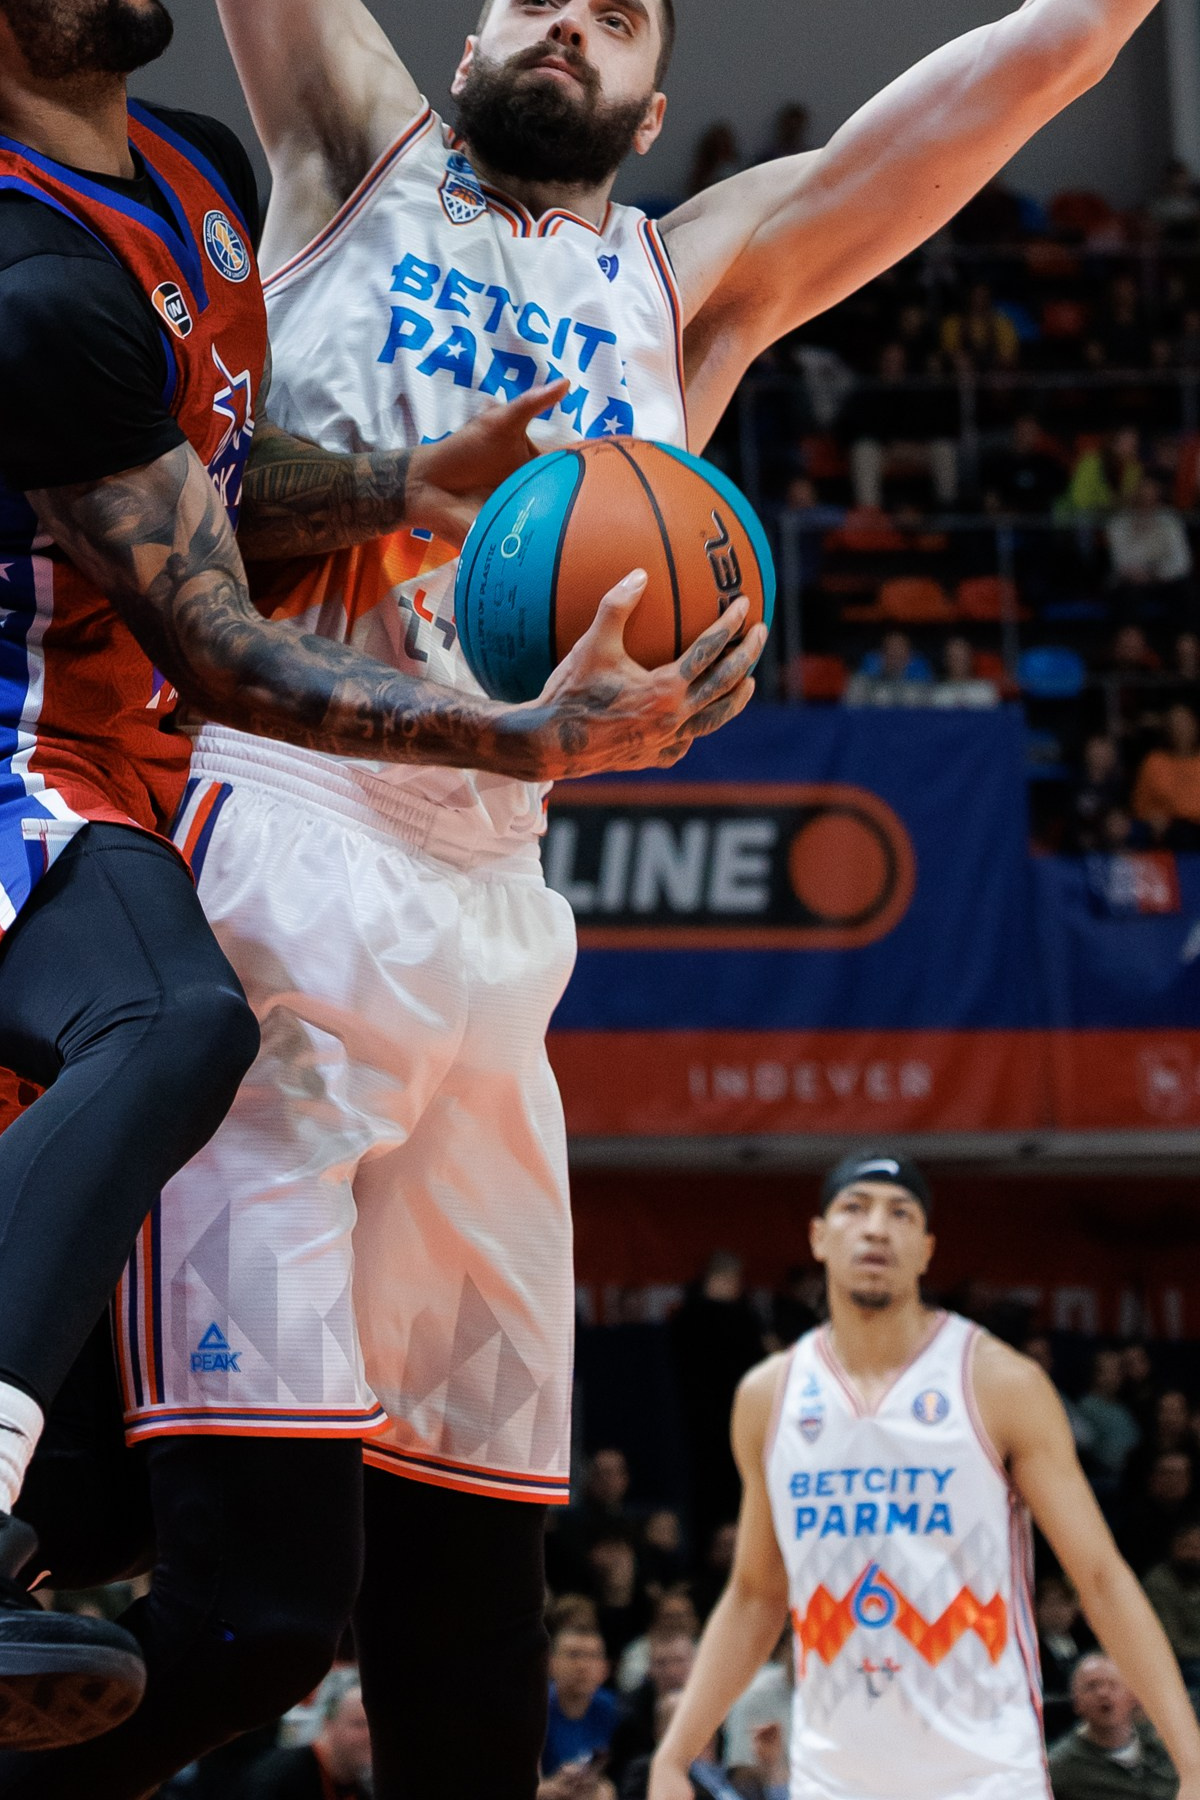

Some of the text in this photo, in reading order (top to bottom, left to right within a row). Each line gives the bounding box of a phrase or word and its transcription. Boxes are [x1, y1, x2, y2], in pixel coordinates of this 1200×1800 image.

[390, 252, 627, 387] BETCIT
[480, 543, 497, 595] PLASTIC
[546, 816, 778, 913] LINE
[191, 1351, 241, 1373] PEAK
[789, 1467, 955, 1498] BETCITY
[796, 1503, 954, 1540] PARMA
[853, 1562, 896, 1630] 6
